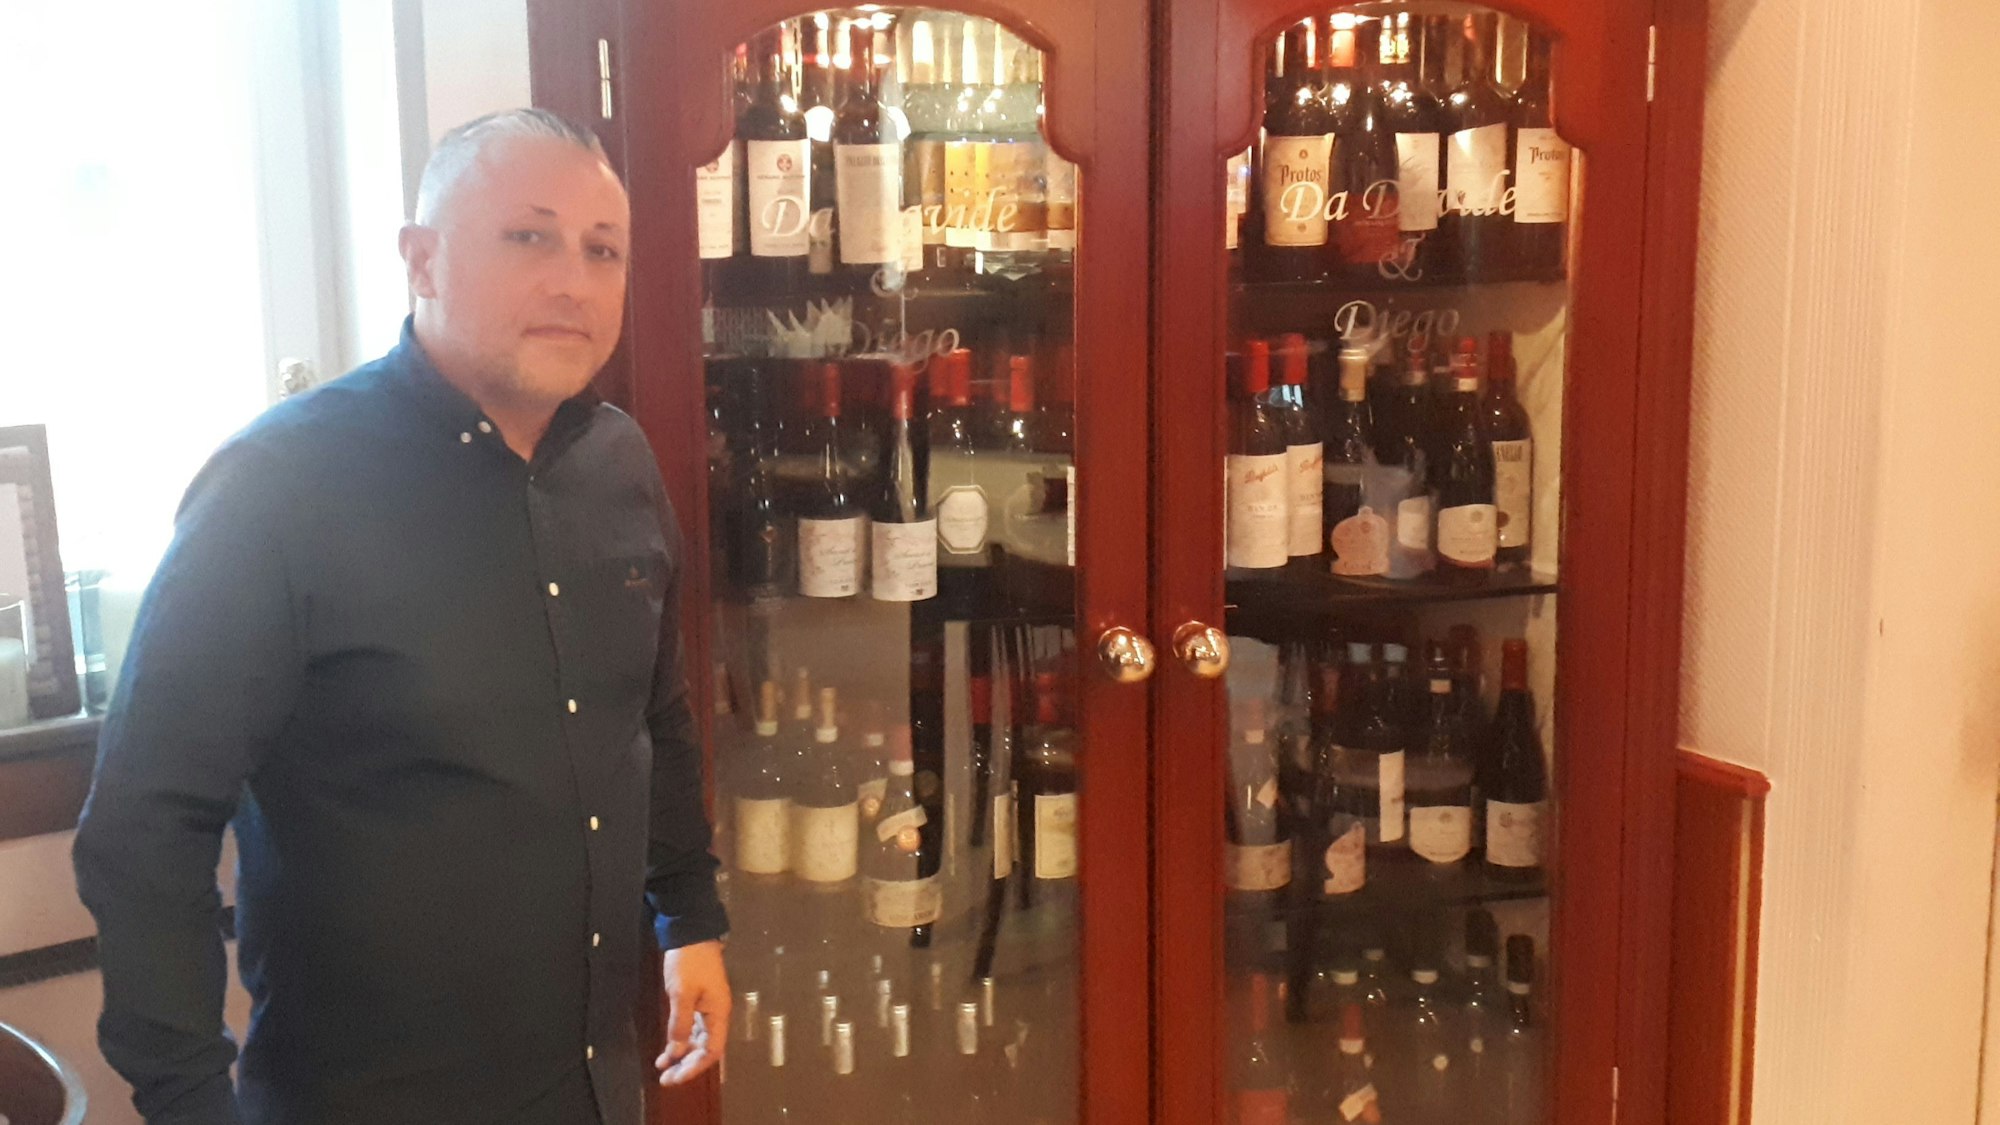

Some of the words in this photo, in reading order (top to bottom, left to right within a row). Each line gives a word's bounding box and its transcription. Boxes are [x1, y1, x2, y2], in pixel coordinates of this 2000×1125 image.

[1278, 164, 1322, 185] Protos
[1279, 181, 1349, 222] Da
[1362, 169, 1517, 222] Dvide
[761, 195, 836, 238] Da
[894, 186, 1019, 235] avide
[1333, 299, 1460, 353] Diego
